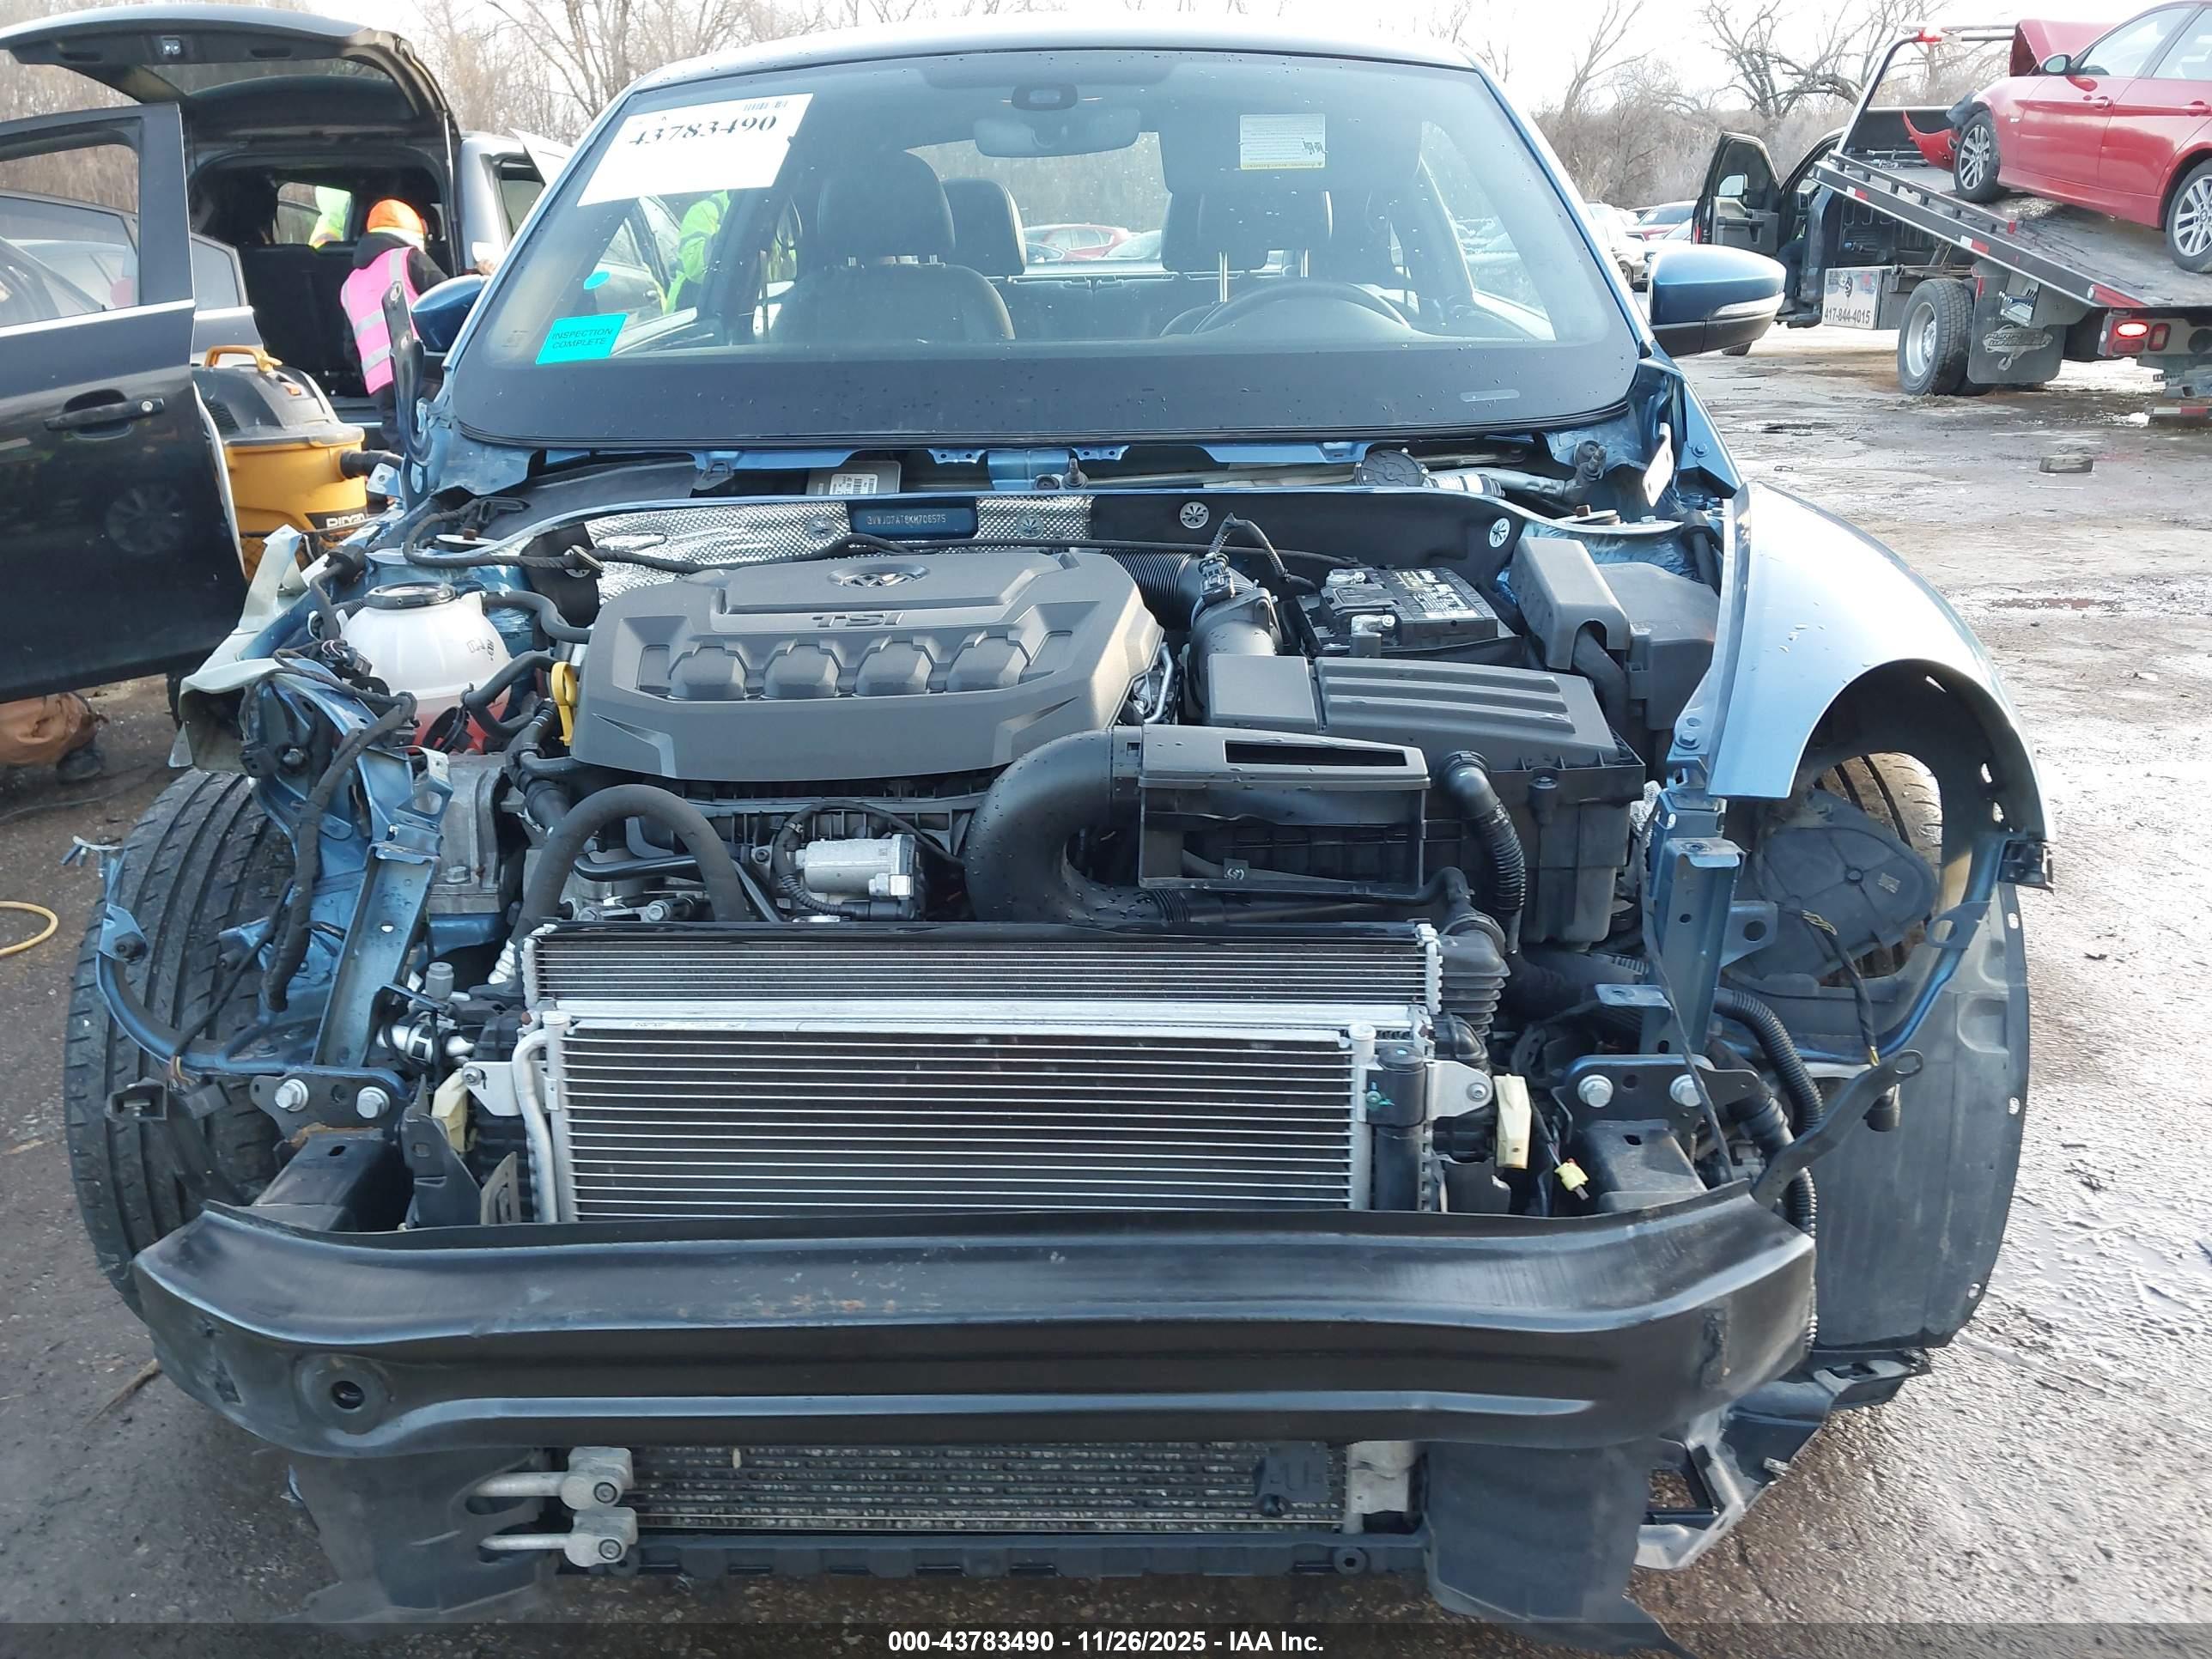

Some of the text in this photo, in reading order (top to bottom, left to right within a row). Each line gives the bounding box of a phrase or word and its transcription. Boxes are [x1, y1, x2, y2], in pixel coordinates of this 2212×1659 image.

[628, 115, 777, 145] 43783490
[1824, 307, 1871, 325] 417-844-4015
[551, 328, 614, 340] INSPECTION
[551, 337, 608, 349] COMPLETE
[811, 612, 905, 629] TSI
